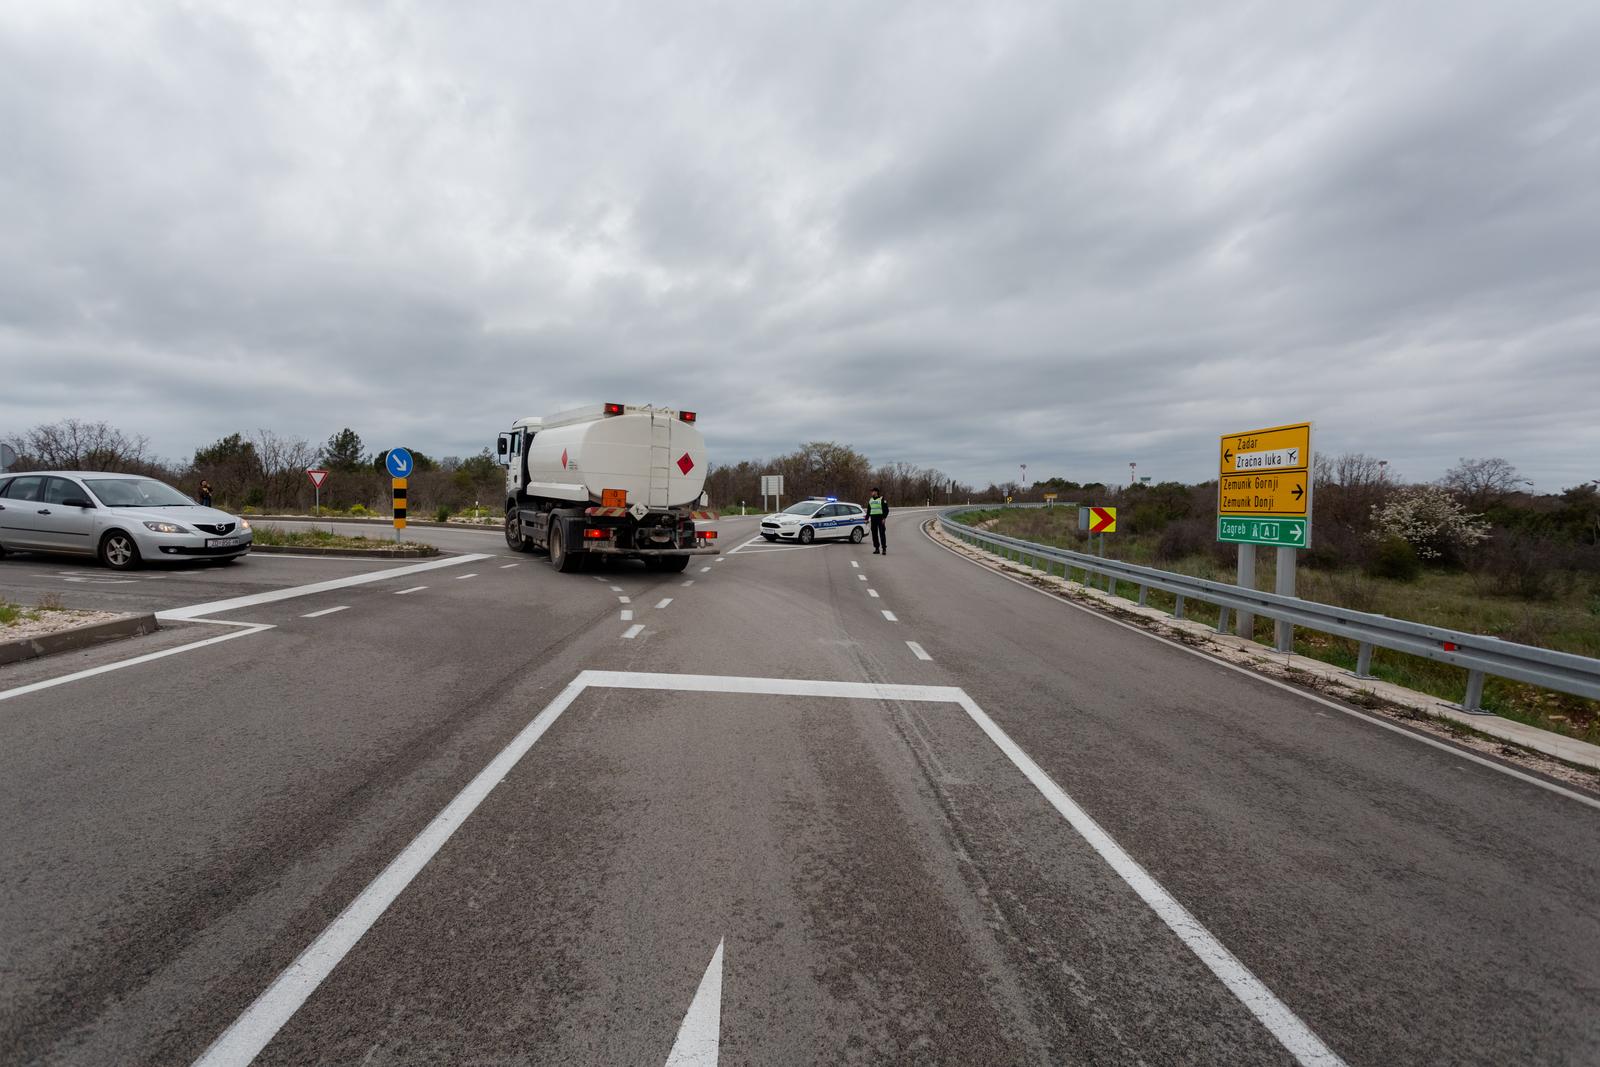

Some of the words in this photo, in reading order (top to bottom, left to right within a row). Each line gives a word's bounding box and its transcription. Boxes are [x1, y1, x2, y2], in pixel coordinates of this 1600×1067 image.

[1237, 438, 1258, 450] Zadar
[1236, 456, 1262, 468] Zračna
[1264, 454, 1281, 466] luka
[1223, 478, 1251, 490] Zemunik
[1254, 477, 1278, 491] Gornji
[1223, 496, 1251, 507] Zemunik
[1254, 495, 1274, 510] Donji
[1222, 522, 1246, 536] Zagreb
